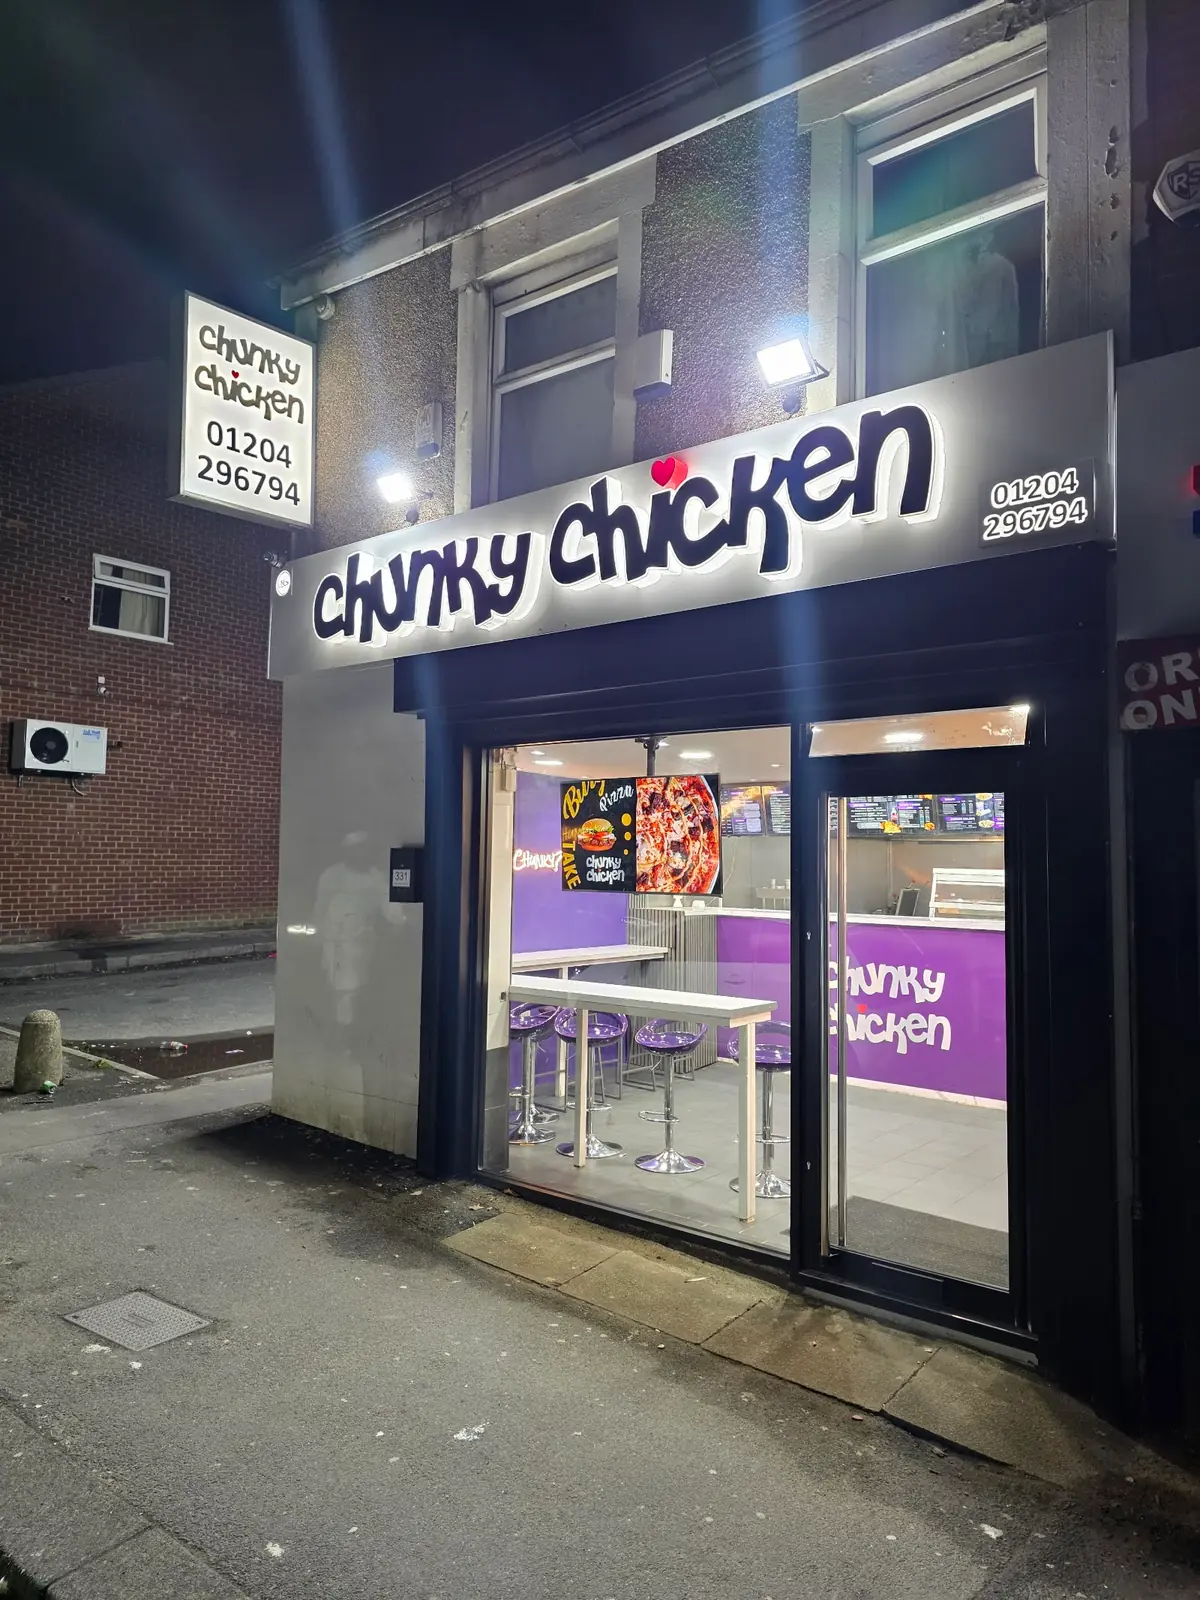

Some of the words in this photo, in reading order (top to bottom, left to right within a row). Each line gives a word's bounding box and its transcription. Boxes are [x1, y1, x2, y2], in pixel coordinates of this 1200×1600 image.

[198, 324, 301, 385] chunky
[194, 364, 305, 424] chicken
[206, 420, 292, 469] 01204
[197, 454, 300, 506] 296794
[990, 466, 1080, 509] 01204
[312, 532, 536, 645] chunky
[547, 402, 938, 587] chicken
[983, 497, 1089, 541] 296794
[1124, 648, 1200, 692] OR
[1123, 687, 1200, 730] ON
[600, 785, 635, 811] Pizza
[394, 871, 408, 881] 331
[562, 840, 582, 889] TAKE
[586, 854, 622, 869] chunky
[586, 867, 625, 885] chicken
